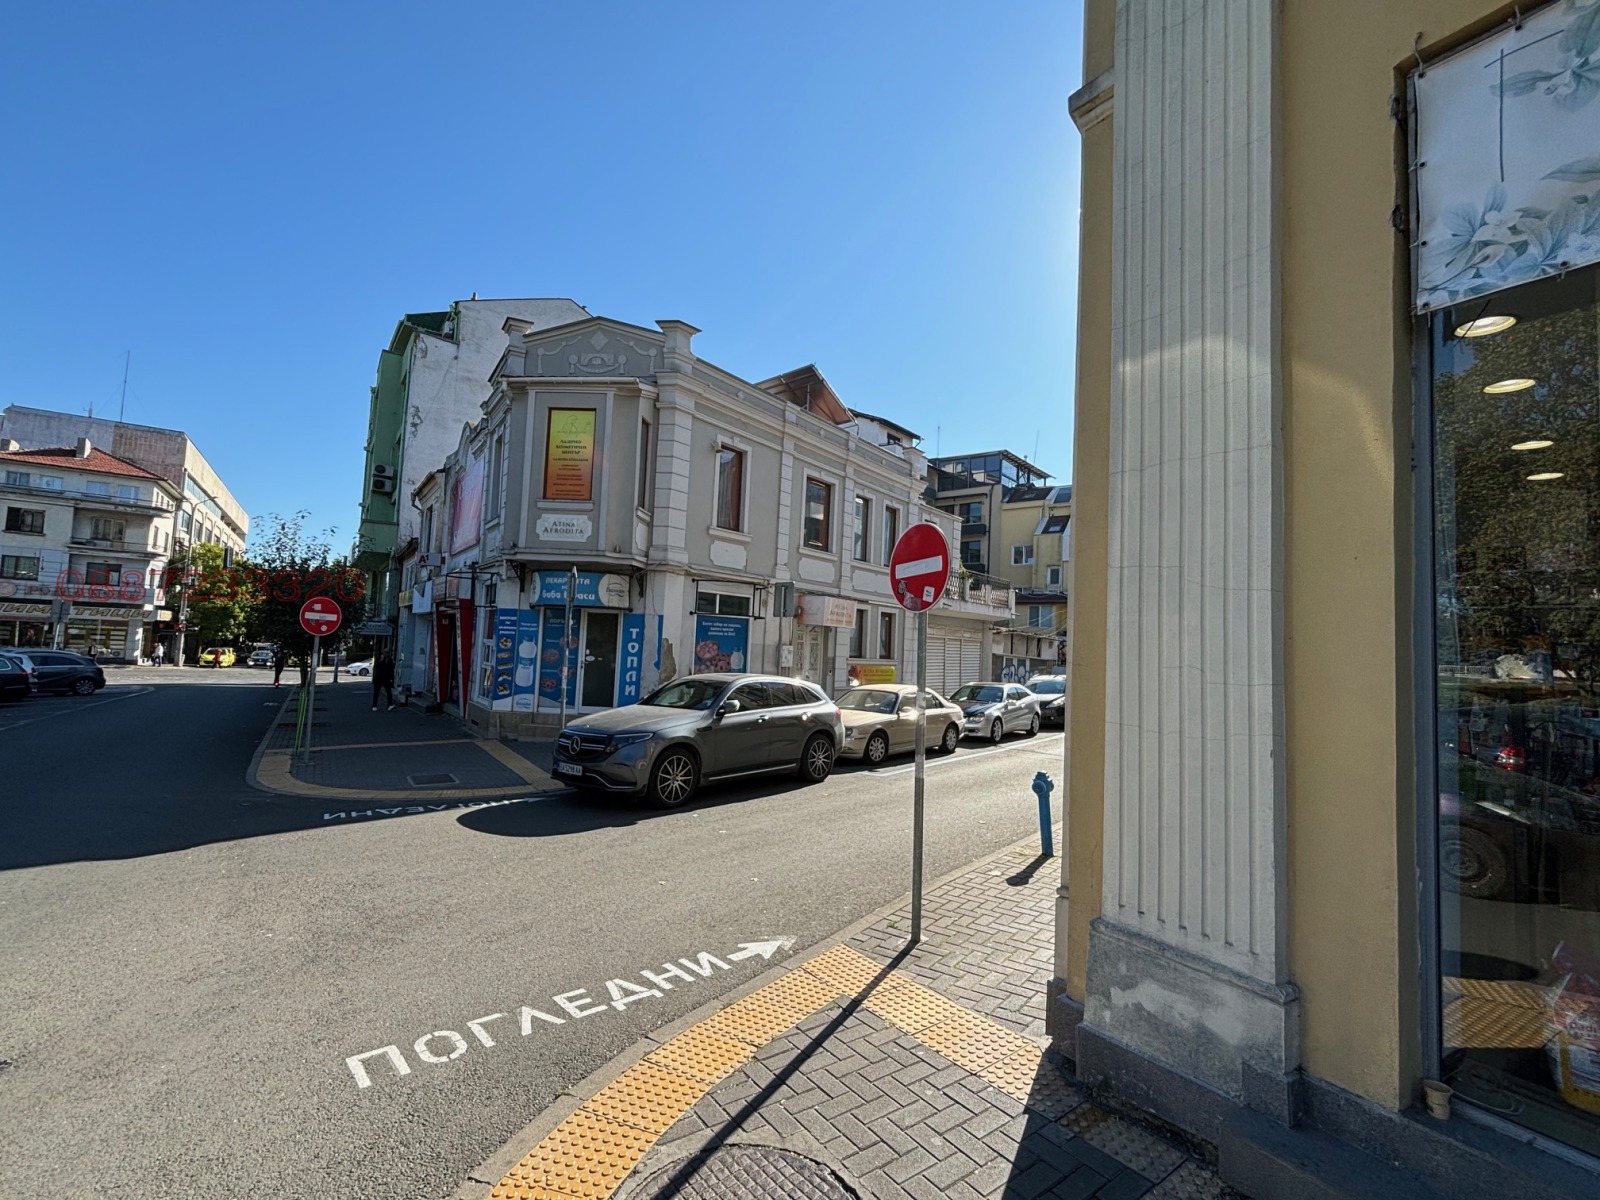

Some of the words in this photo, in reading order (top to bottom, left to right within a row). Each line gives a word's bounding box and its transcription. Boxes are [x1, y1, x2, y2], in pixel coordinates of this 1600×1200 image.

[542, 526, 584, 535] AFRODITA
[551, 520, 576, 528] ATINA
[73, 606, 153, 619] ТИЦИ
[624, 628, 640, 696] ТОПЛИ
[345, 950, 732, 1089] ПОГЛЕДНИ
